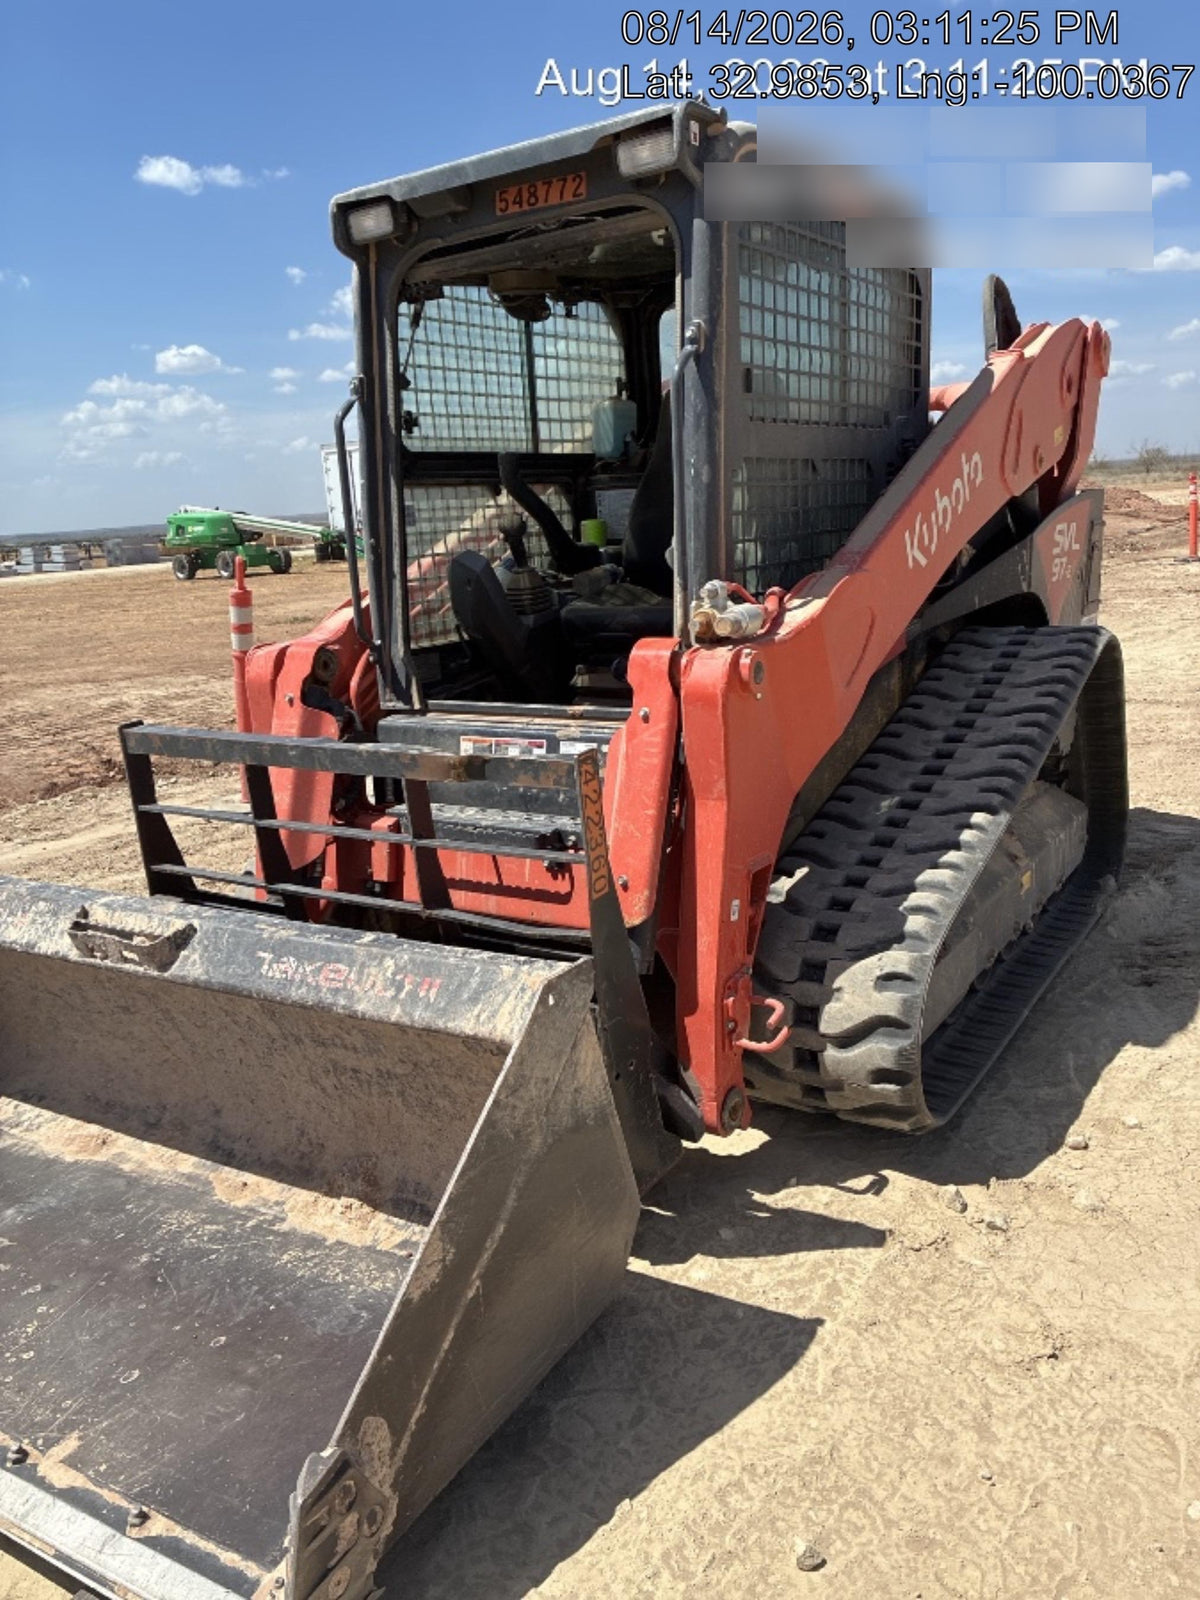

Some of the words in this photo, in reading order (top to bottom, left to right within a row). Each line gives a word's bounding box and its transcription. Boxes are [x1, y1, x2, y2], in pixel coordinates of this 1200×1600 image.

[498, 173, 584, 214] 548772
[904, 451, 983, 569] Kubota
[1052, 522, 1080, 555] SVL
